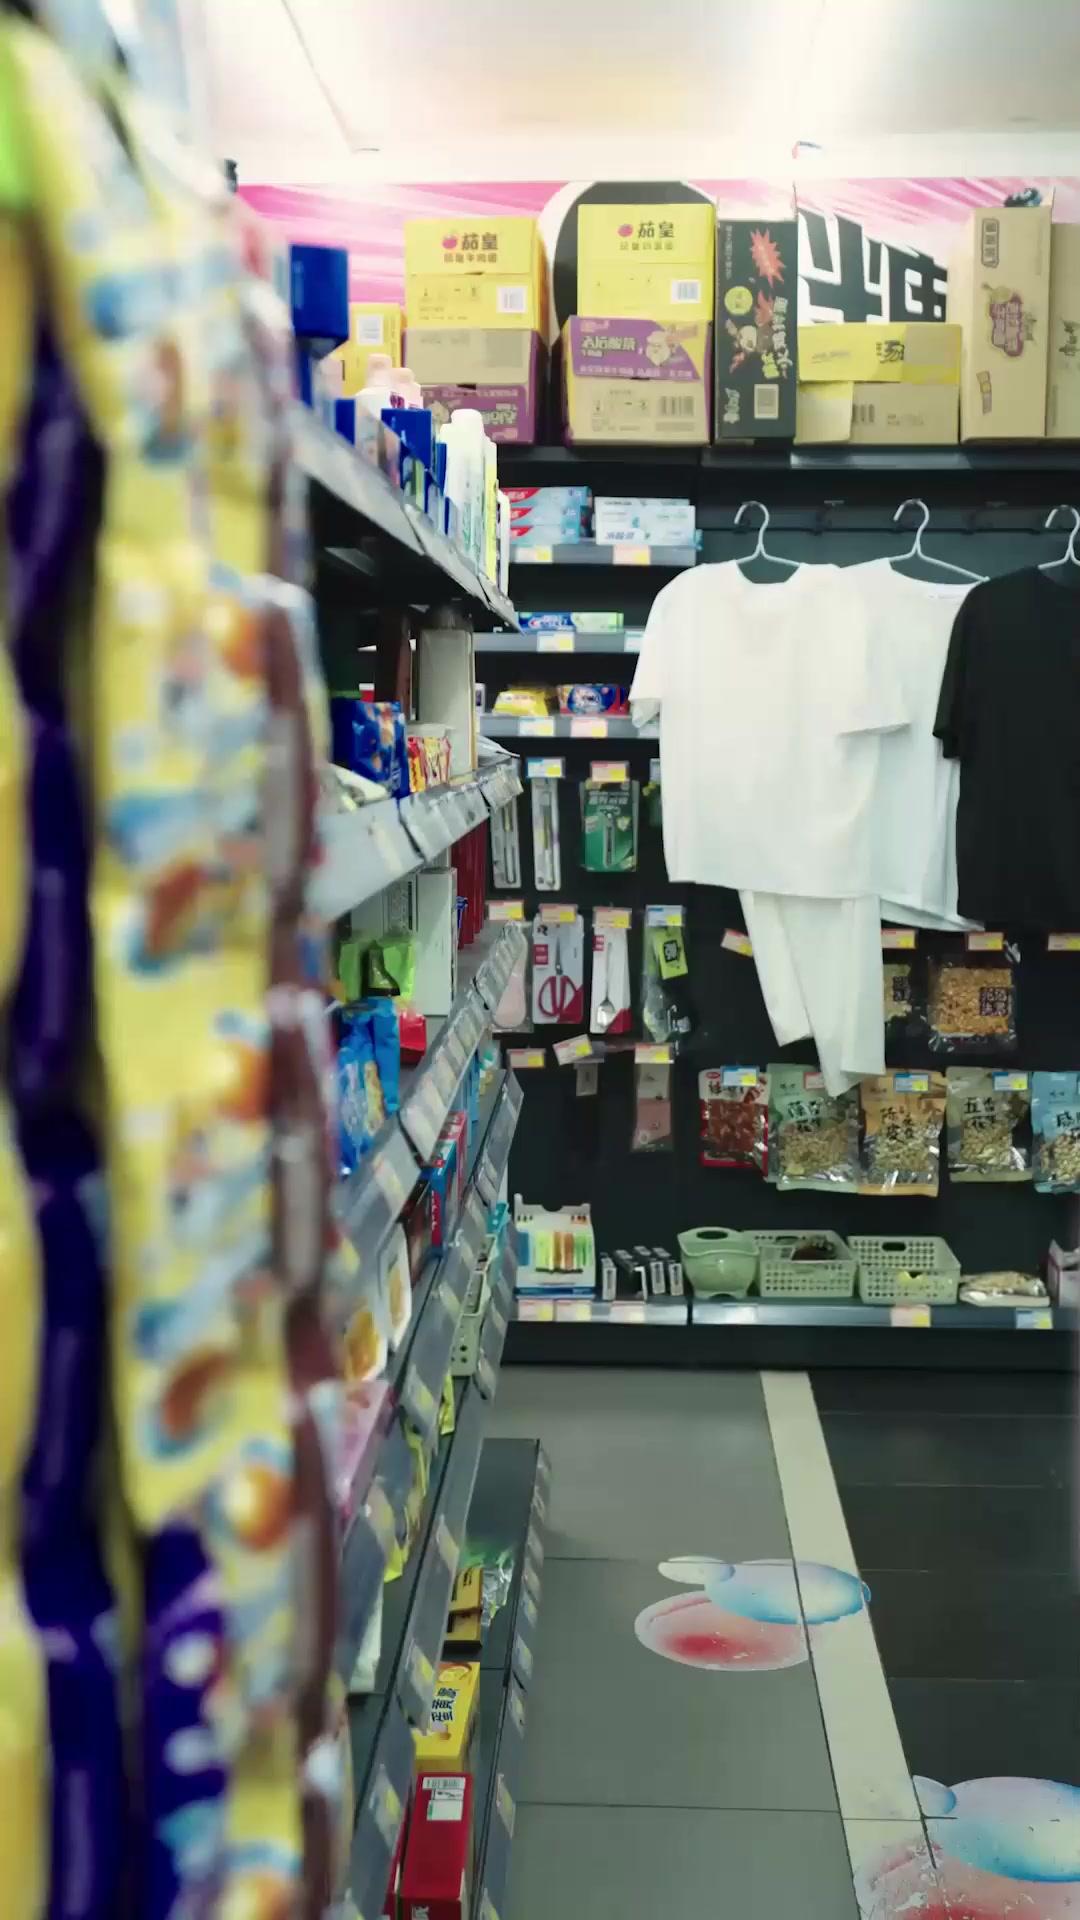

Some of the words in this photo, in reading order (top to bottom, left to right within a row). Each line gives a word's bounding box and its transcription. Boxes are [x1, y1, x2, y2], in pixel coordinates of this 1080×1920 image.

[638, 220, 675, 238] 茄皇
[461, 232, 498, 250] 茄皇
[964, 1097, 995, 1114] 五香
